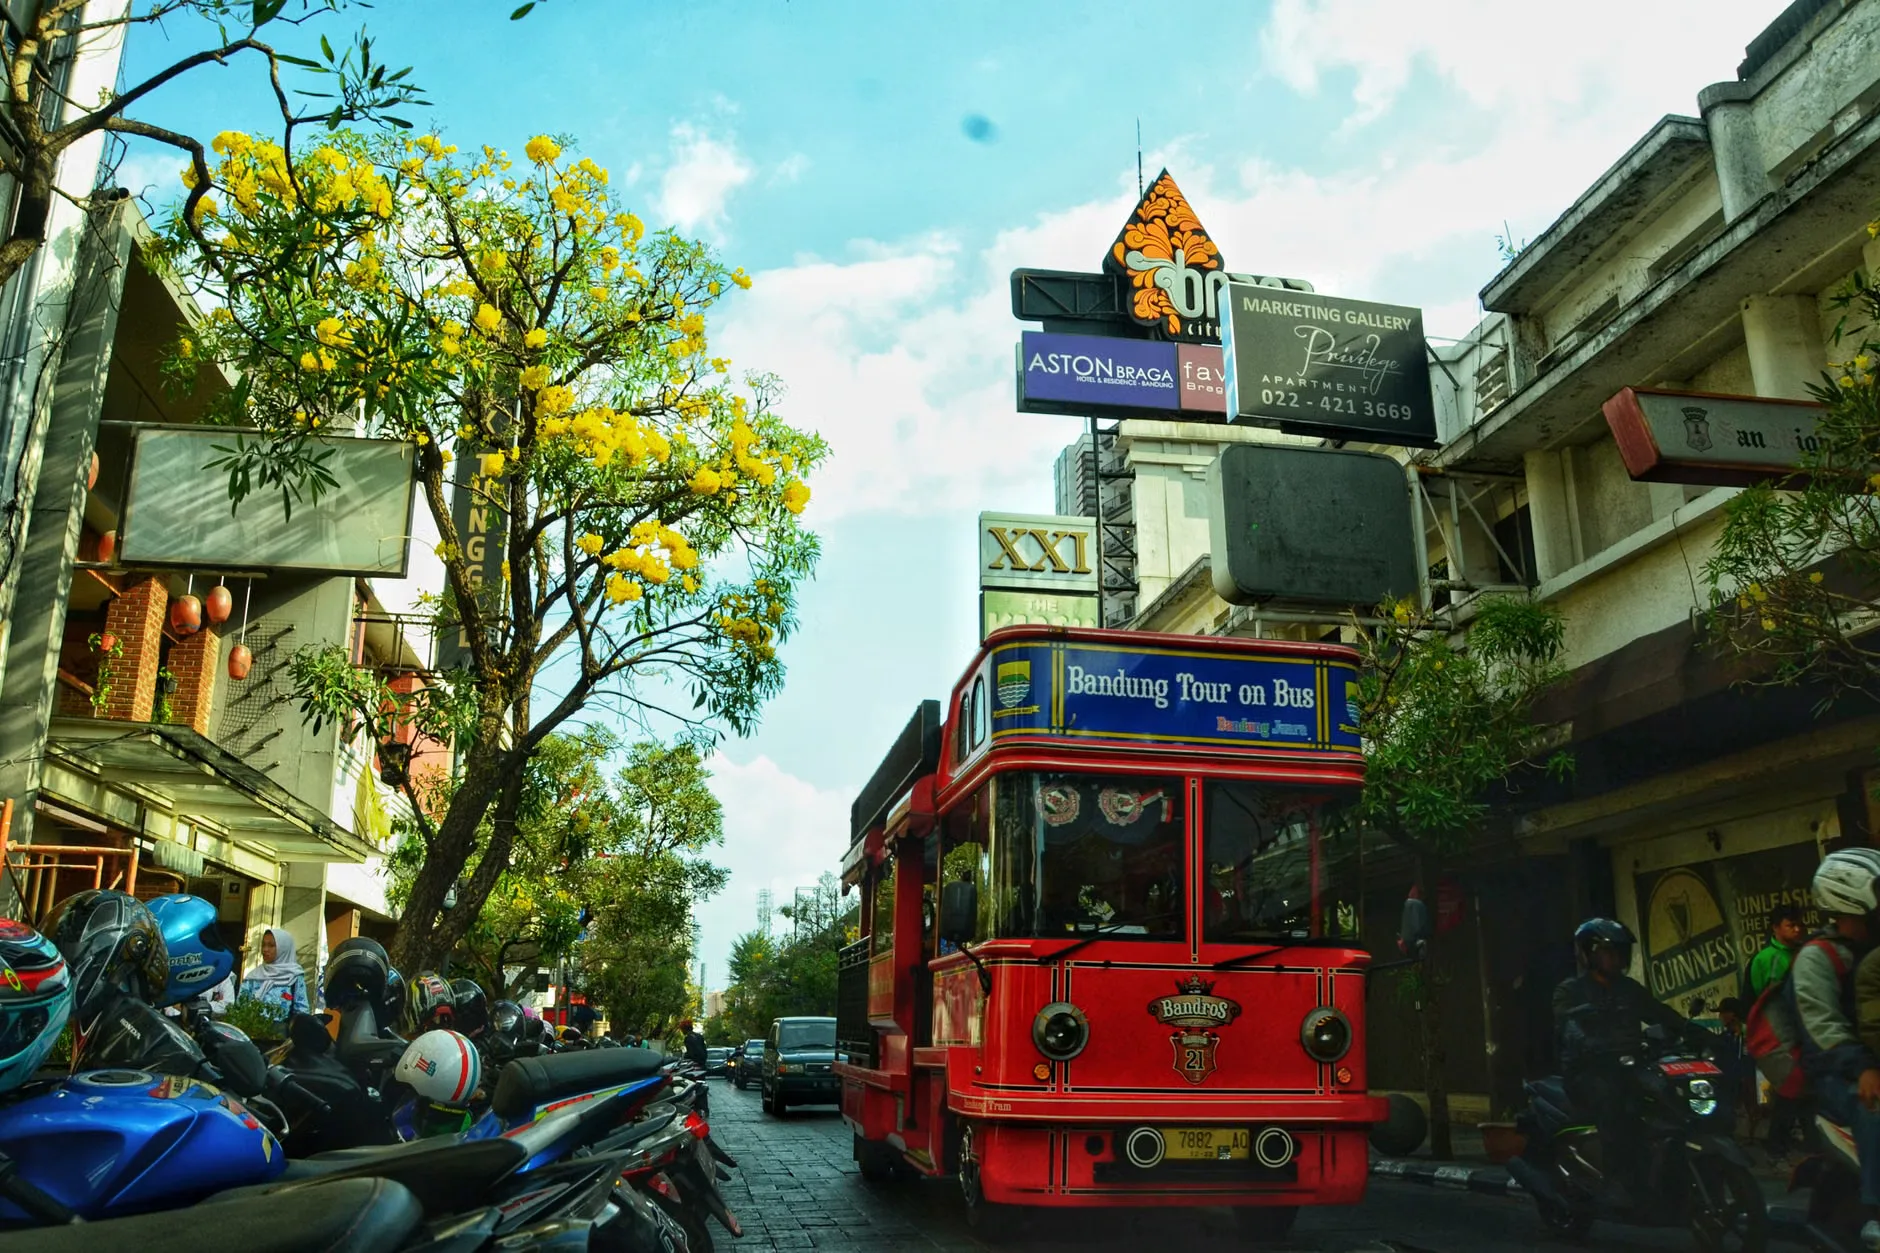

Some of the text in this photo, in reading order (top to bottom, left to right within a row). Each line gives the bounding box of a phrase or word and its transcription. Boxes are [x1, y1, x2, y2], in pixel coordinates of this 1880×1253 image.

[1243, 297, 1412, 331] MARKETING GALLERY
[1028, 352, 1173, 382] ASTON BRAGA
[1294, 325, 1400, 395] Privilege
[1104, 378, 1137, 386] RESIDENCE
[1142, 381, 1174, 389] BANDUNG
[1261, 374, 1368, 393] APARTMENT
[1261, 389, 1300, 407] 022
[1320, 396, 1357, 414] 421
[1364, 401, 1412, 420] 3669
[458, 453, 490, 648] TUNGGL
[988, 527, 1092, 574] XXI
[1029, 600, 1058, 613] THE
[1068, 666, 1314, 708] Bandung Tour on Bus
[1651, 932, 1736, 995] GUINNESS
[1161, 997, 1228, 1019] Bandros
[1185, 1048, 1205, 1071] 21
[1178, 1131, 1212, 1149] 7882
